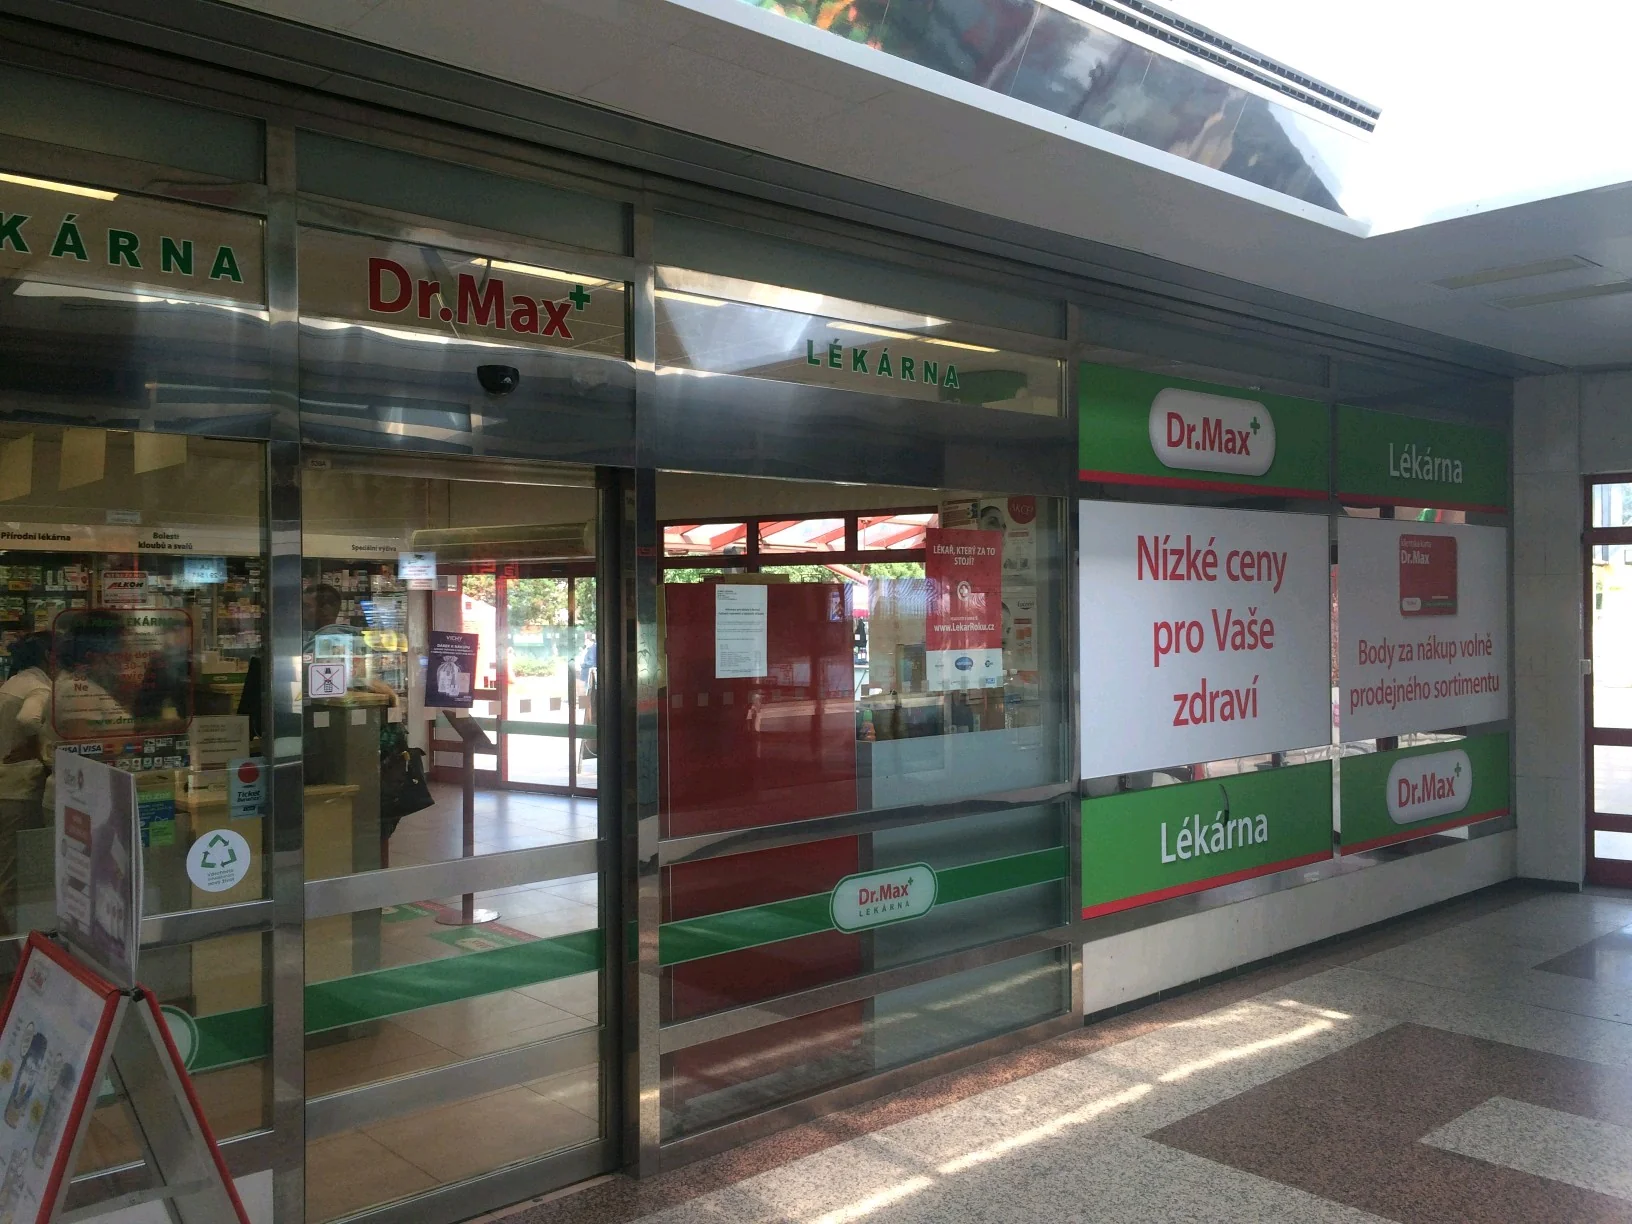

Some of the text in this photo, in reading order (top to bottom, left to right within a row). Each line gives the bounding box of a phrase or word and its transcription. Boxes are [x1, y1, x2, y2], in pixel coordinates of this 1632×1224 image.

[806, 338, 961, 390] LÉKÁRNA
[1165, 410, 1251, 457] Dr.Max
[1388, 442, 1464, 484] Lékárna
[0, 531, 72, 541] Přírodní lékárna
[138, 541, 167, 549] kloubů
[152, 531, 180, 540] Bolesti
[351, 544, 378, 552] Speciální
[933, 543, 996, 556] LÉKAŘ, KTERÝ ZA TO
[1401, 549, 1430, 565] Dr.Max
[954, 556, 975, 566] STOJÍ?
[1136, 534, 1288, 594] Nízké ceny
[933, 622, 995, 632] www.LekarRoku.cz
[1153, 606, 1276, 668] pro Vaše
[1358, 631, 1493, 670] Body za nákup volně
[74, 683, 89, 692] Ne
[1350, 671, 1500, 716] prodejného sortimentu
[1172, 674, 1260, 727] zdraví
[83, 744, 102, 753] VISA
[1397, 771, 1456, 809] Dr.Max
[1160, 810, 1268, 864] Lékárna
[858, 883, 909, 906] Dr.Max
